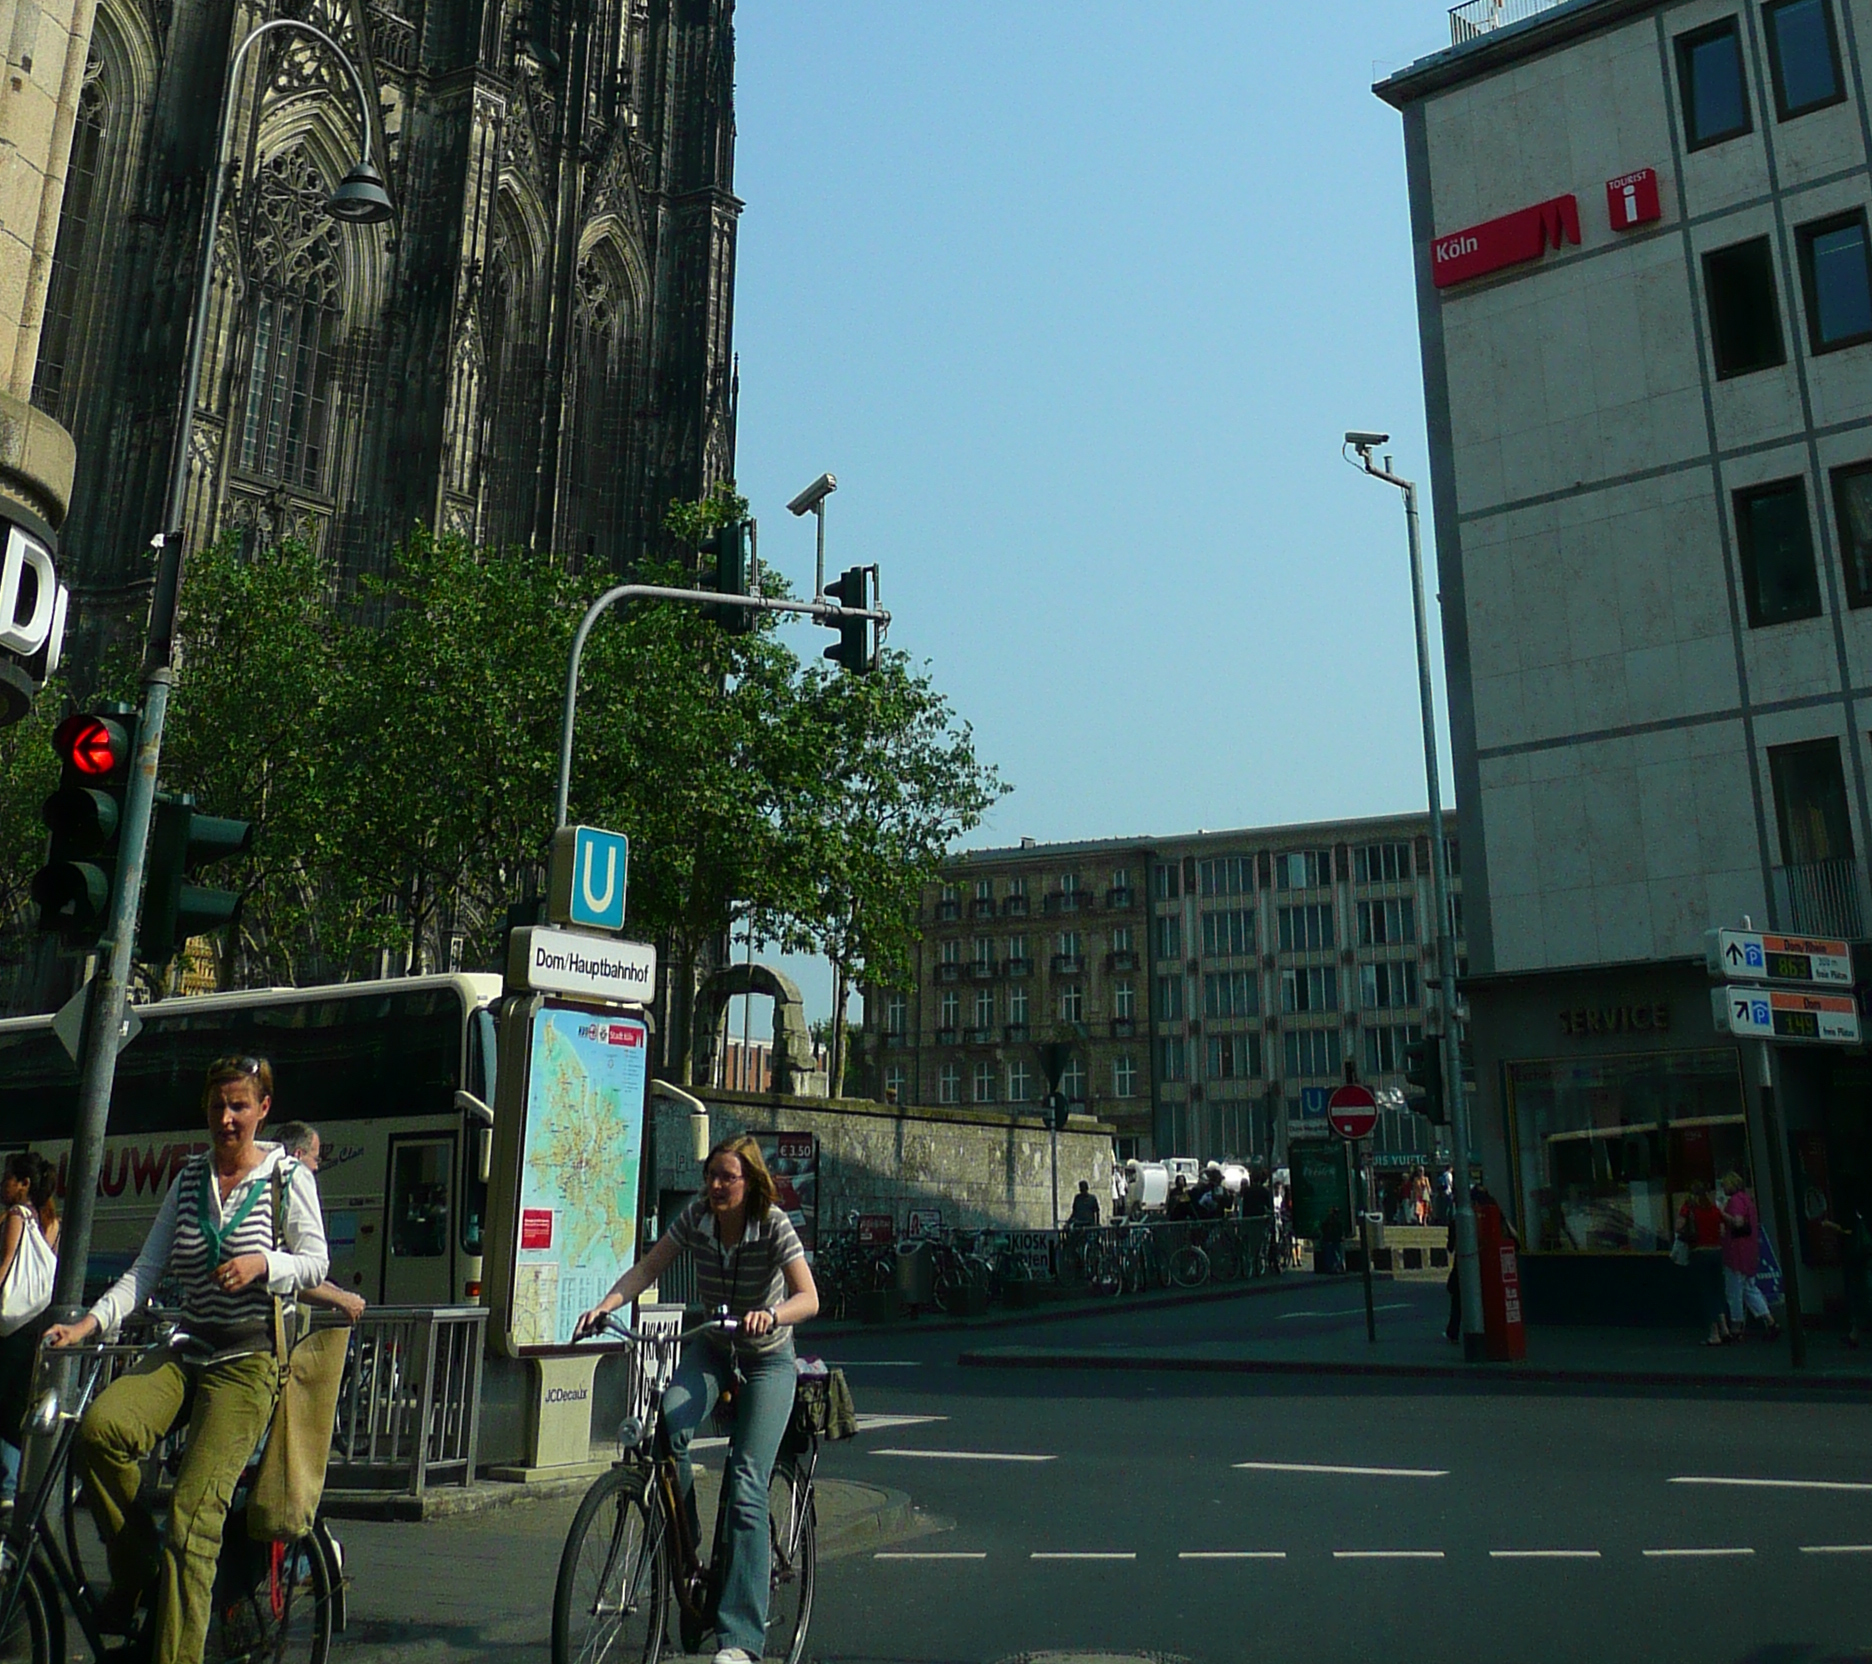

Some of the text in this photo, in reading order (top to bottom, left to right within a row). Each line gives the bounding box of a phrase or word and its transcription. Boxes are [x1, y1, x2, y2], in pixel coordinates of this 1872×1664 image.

[1608, 170, 1648, 190] TOURIST
[1436, 236, 1478, 263] Köln
[582, 840, 616, 913] U
[536, 947, 650, 984] Dom/Hauptbahnhof
[1803, 997, 1821, 1010] Dom
[1559, 1002, 1670, 1034] SERVICE
[1306, 1090, 1322, 1113] U
[788, 1145, 812, 1157] 3.50
[1012, 1233, 1047, 1250] KIOSK
[545, 1386, 588, 1404] JCDecaux
